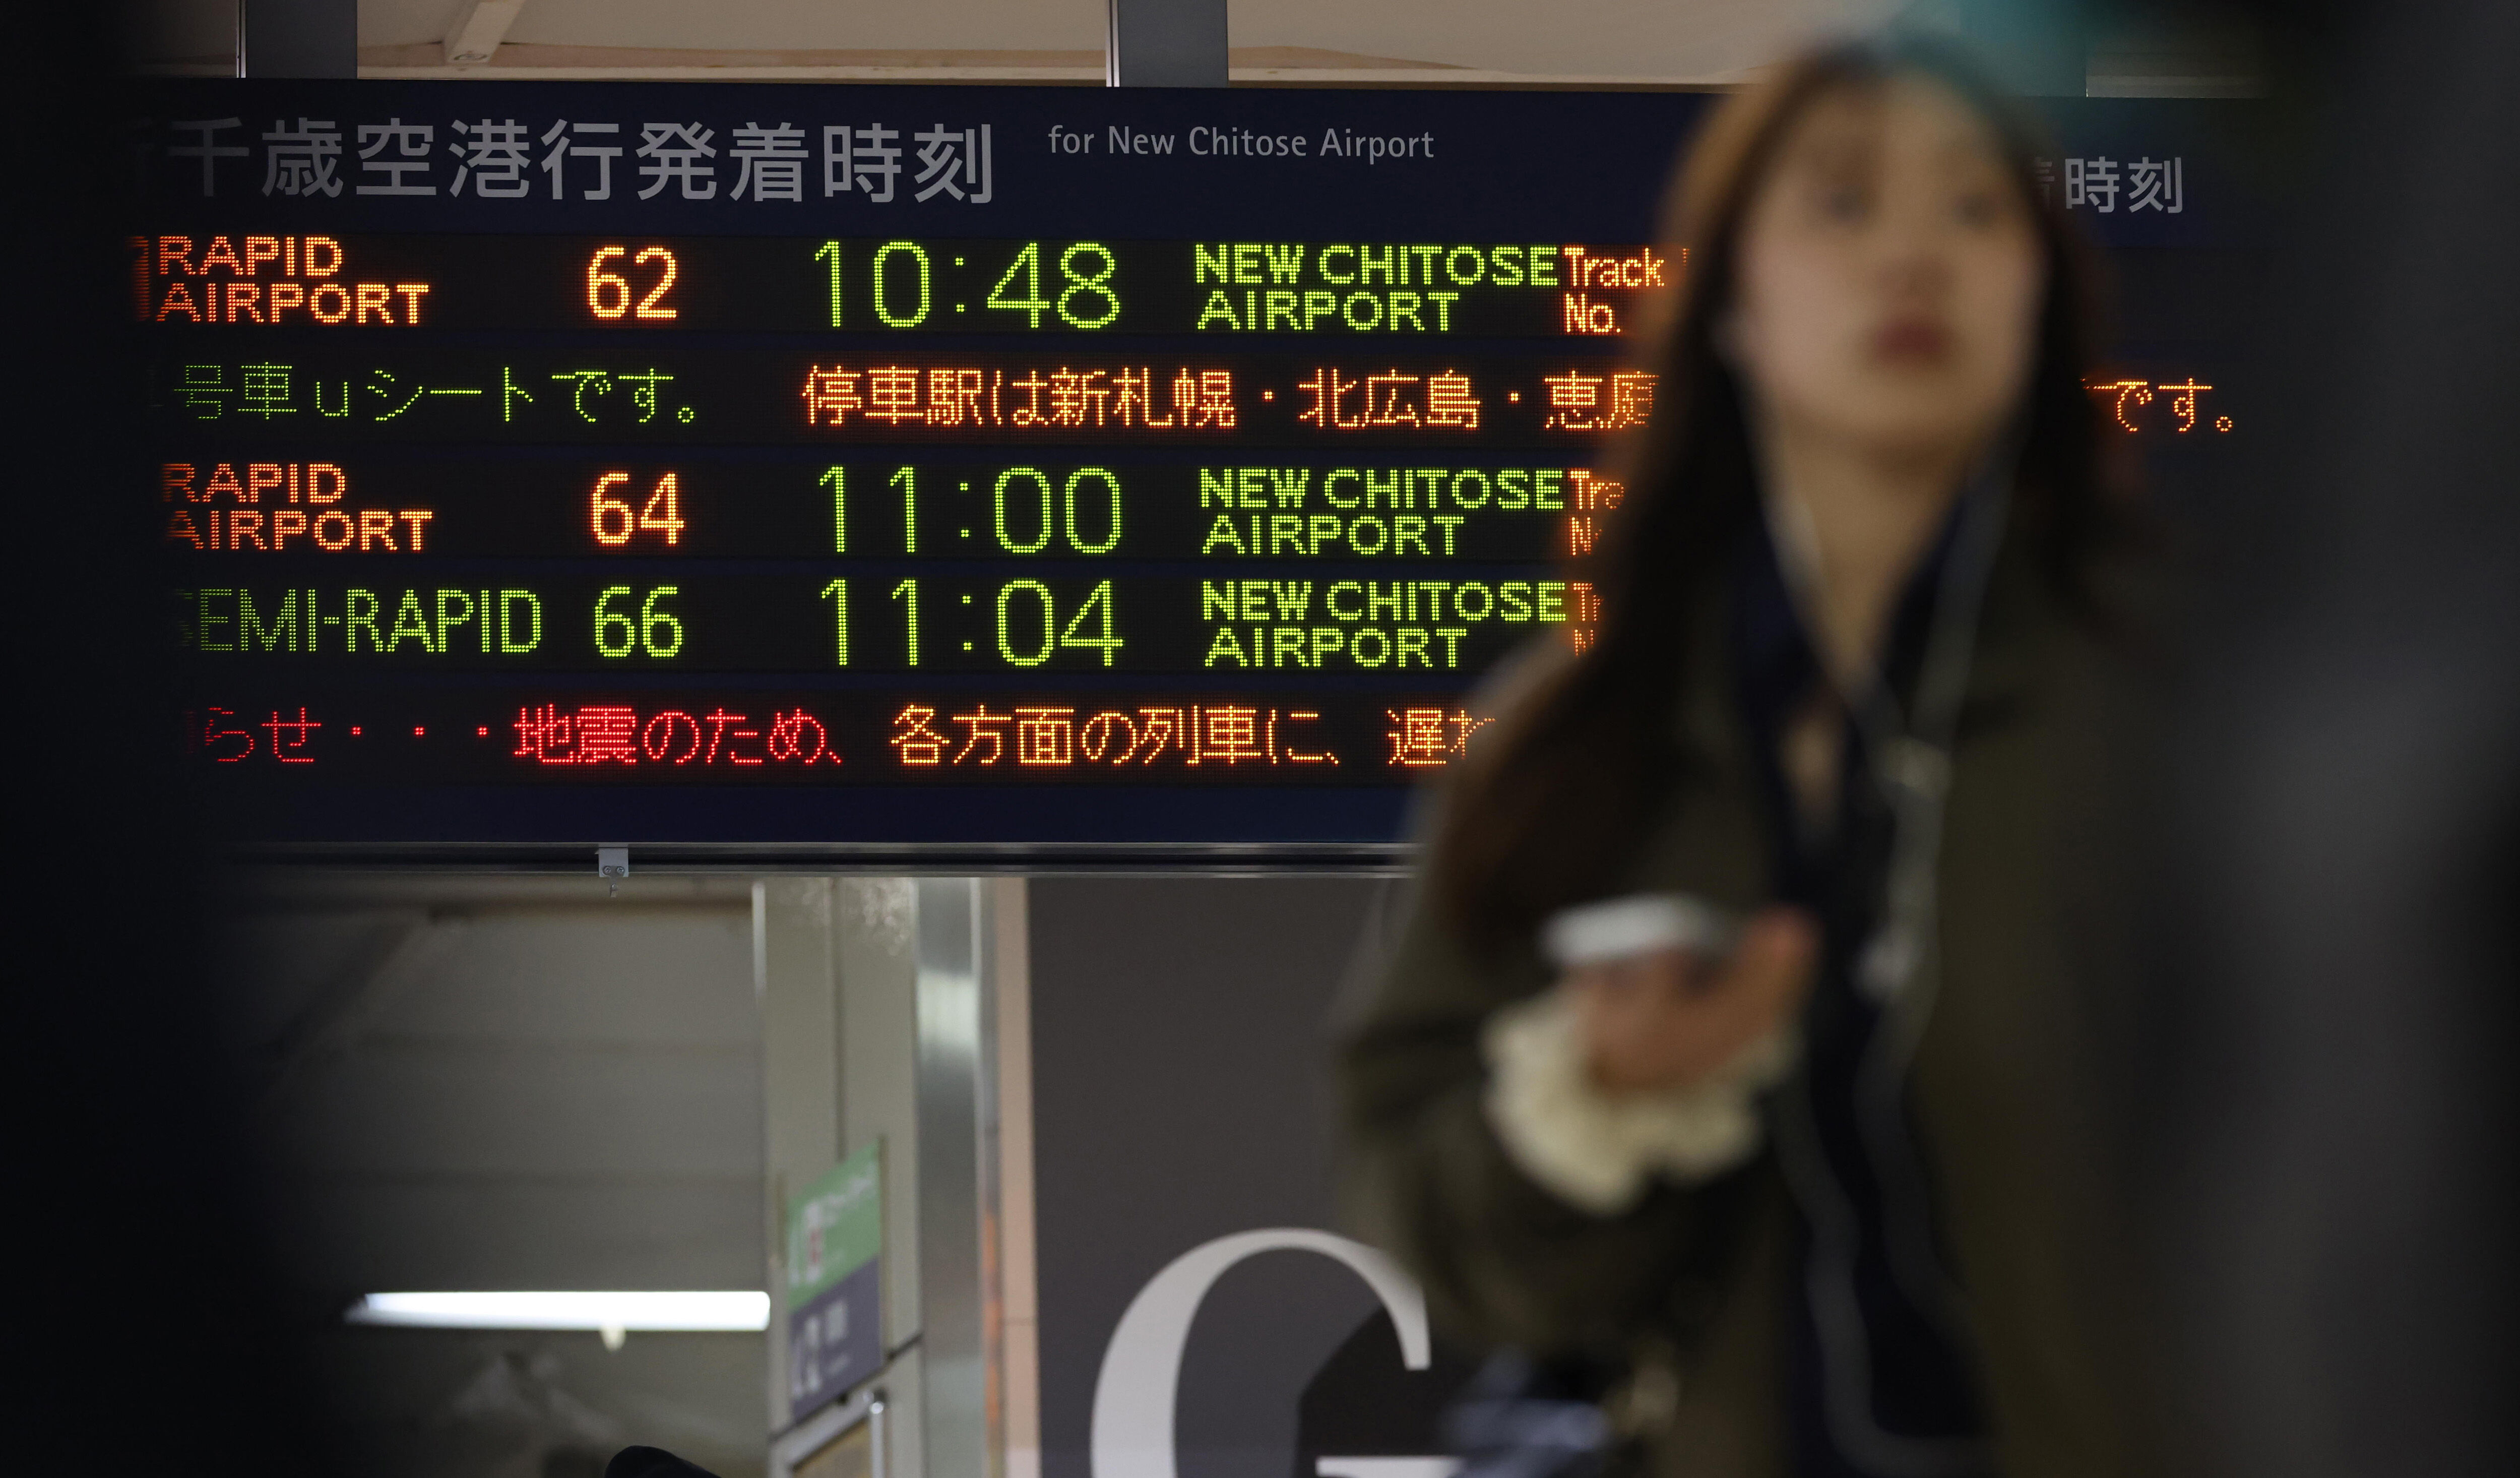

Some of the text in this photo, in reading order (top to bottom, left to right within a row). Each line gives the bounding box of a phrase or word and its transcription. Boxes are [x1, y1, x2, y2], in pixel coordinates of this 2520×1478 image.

[132, 117, 991, 203] 千歳空港行発着時刻
[1048, 125, 1433, 164] for New Chitose Airport
[160, 236, 342, 277] RAPID
[1196, 244, 1557, 285] NEW CHITOSE
[1563, 245, 1665, 288] Track
[157, 282, 430, 325] AIRPORT
[587, 246, 676, 320] 62
[815, 241, 1119, 328] 10:48
[1198, 291, 1459, 331] AIRPORT
[1563, 292, 1620, 335] No.
[147, 362, 694, 422] 号車uシートです。
[162, 464, 346, 504] RAPID
[1201, 469, 1563, 509] NEW CHITOSE
[165, 509, 433, 551] AIRPORT
[591, 473, 684, 546] 64
[820, 467, 1120, 553] 11:00
[1203, 515, 1464, 555] AIRPORT
[595, 587, 682, 657] 66
[1203, 581, 1566, 621] NEW CHITOSE
[822, 580, 1123, 666] 11:04
[1205, 628, 1467, 667] AIRPORT
